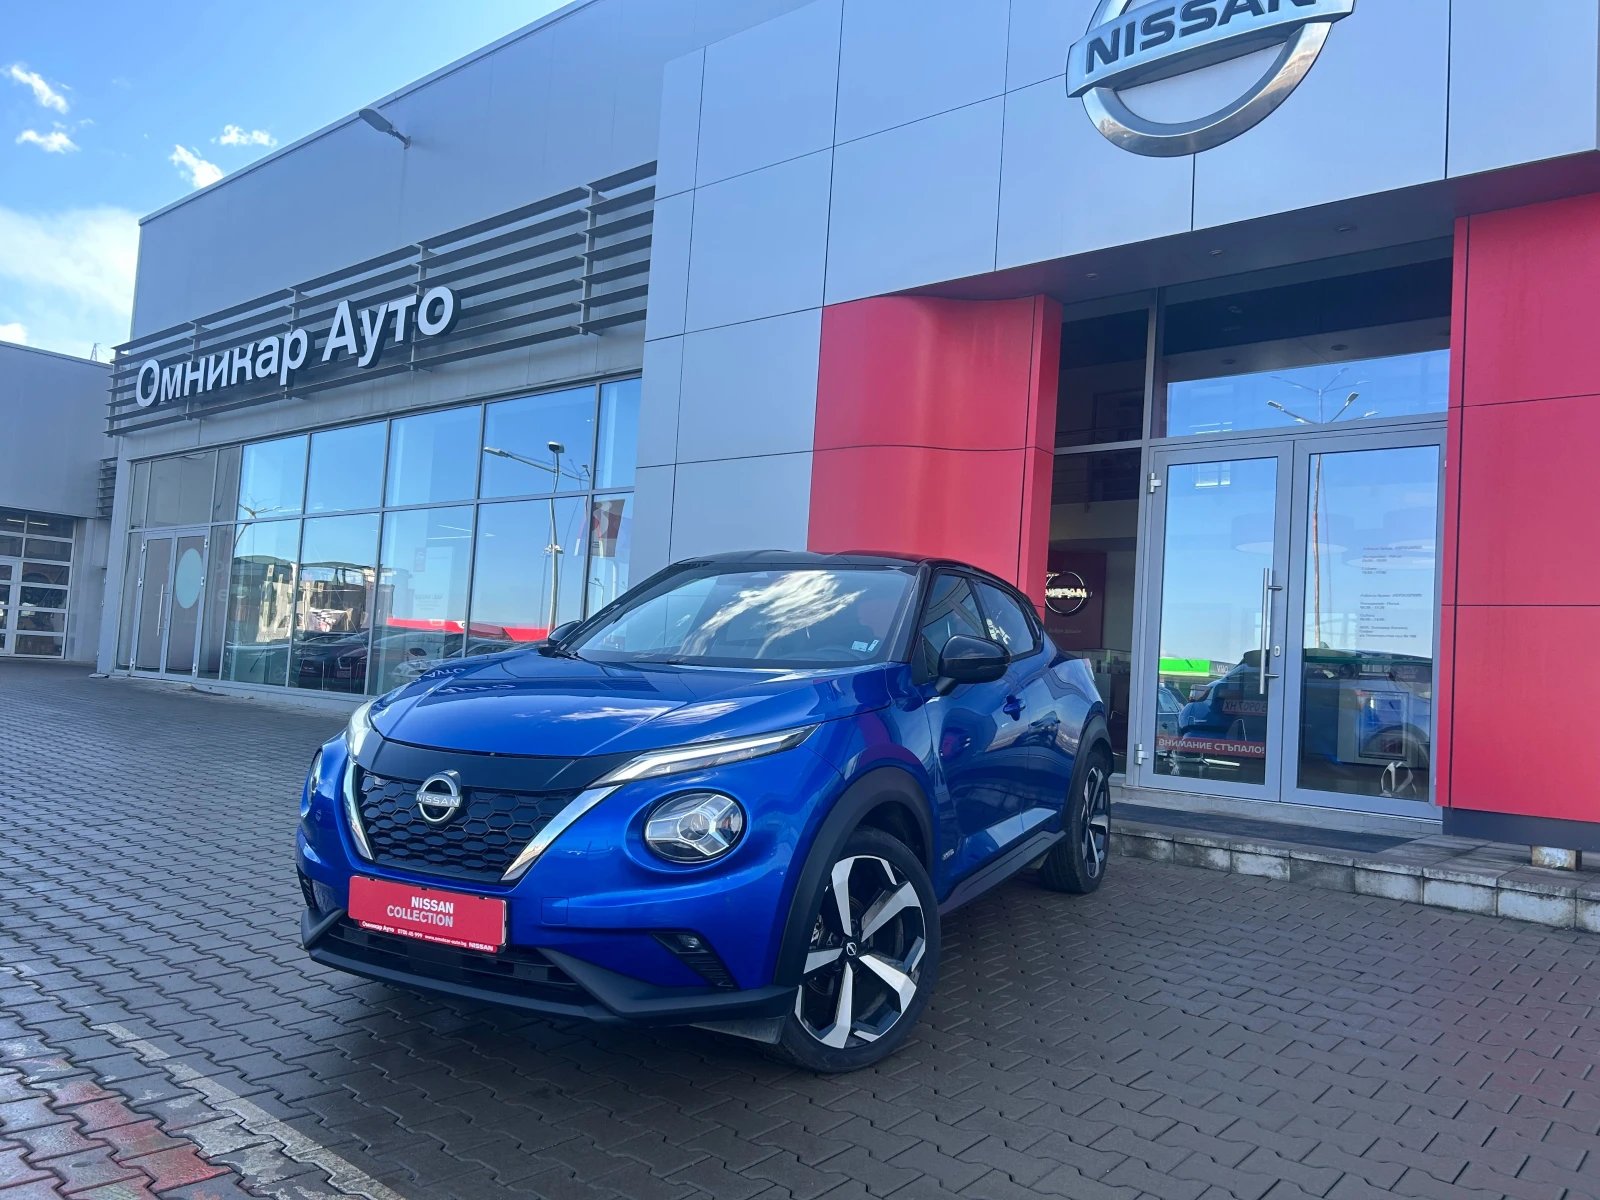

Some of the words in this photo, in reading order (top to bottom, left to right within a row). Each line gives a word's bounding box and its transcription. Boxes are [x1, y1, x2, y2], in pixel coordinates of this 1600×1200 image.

[136, 328, 311, 408] Омникар
[321, 286, 458, 369] Ауто
[1158, 738, 1212, 750] ВНИМАНИЕ
[1214, 743, 1265, 754] СТЪПАЛО!
[416, 793, 459, 806] NISSAN
[411, 896, 454, 914] NISSAN
[386, 905, 454, 928] COLLECTION
[469, 942, 494, 951] NISSAN
